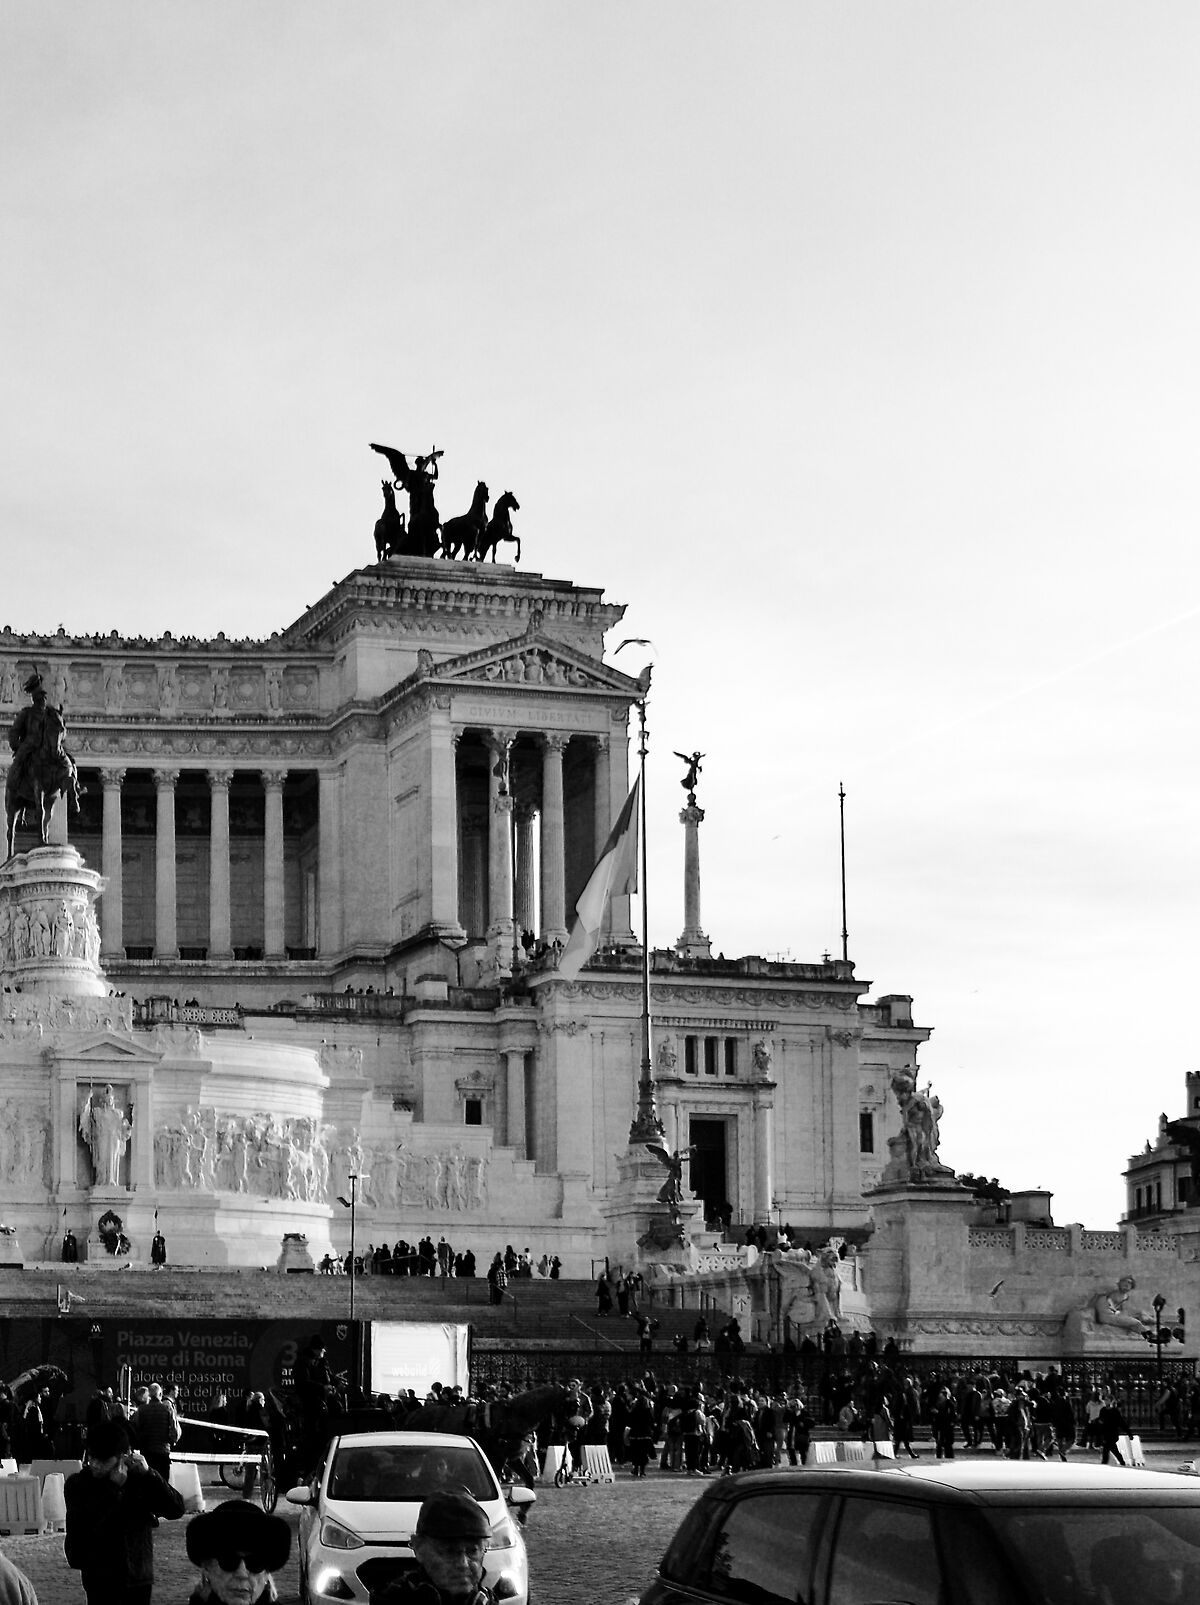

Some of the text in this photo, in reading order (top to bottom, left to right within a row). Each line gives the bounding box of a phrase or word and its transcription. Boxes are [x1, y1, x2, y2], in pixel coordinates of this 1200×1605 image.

[528, 710, 592, 724] LIBERTATI
[117, 1331, 254, 1350] Piazza Venezia,
[116, 1350, 247, 1367] cuore di Roma
[132, 1370, 164, 1382] alore
[166, 1370, 185, 1382] del
[188, 1372, 235, 1384] passato
[193, 1384, 213, 1398] del
[216, 1384, 244, 1398] futur
